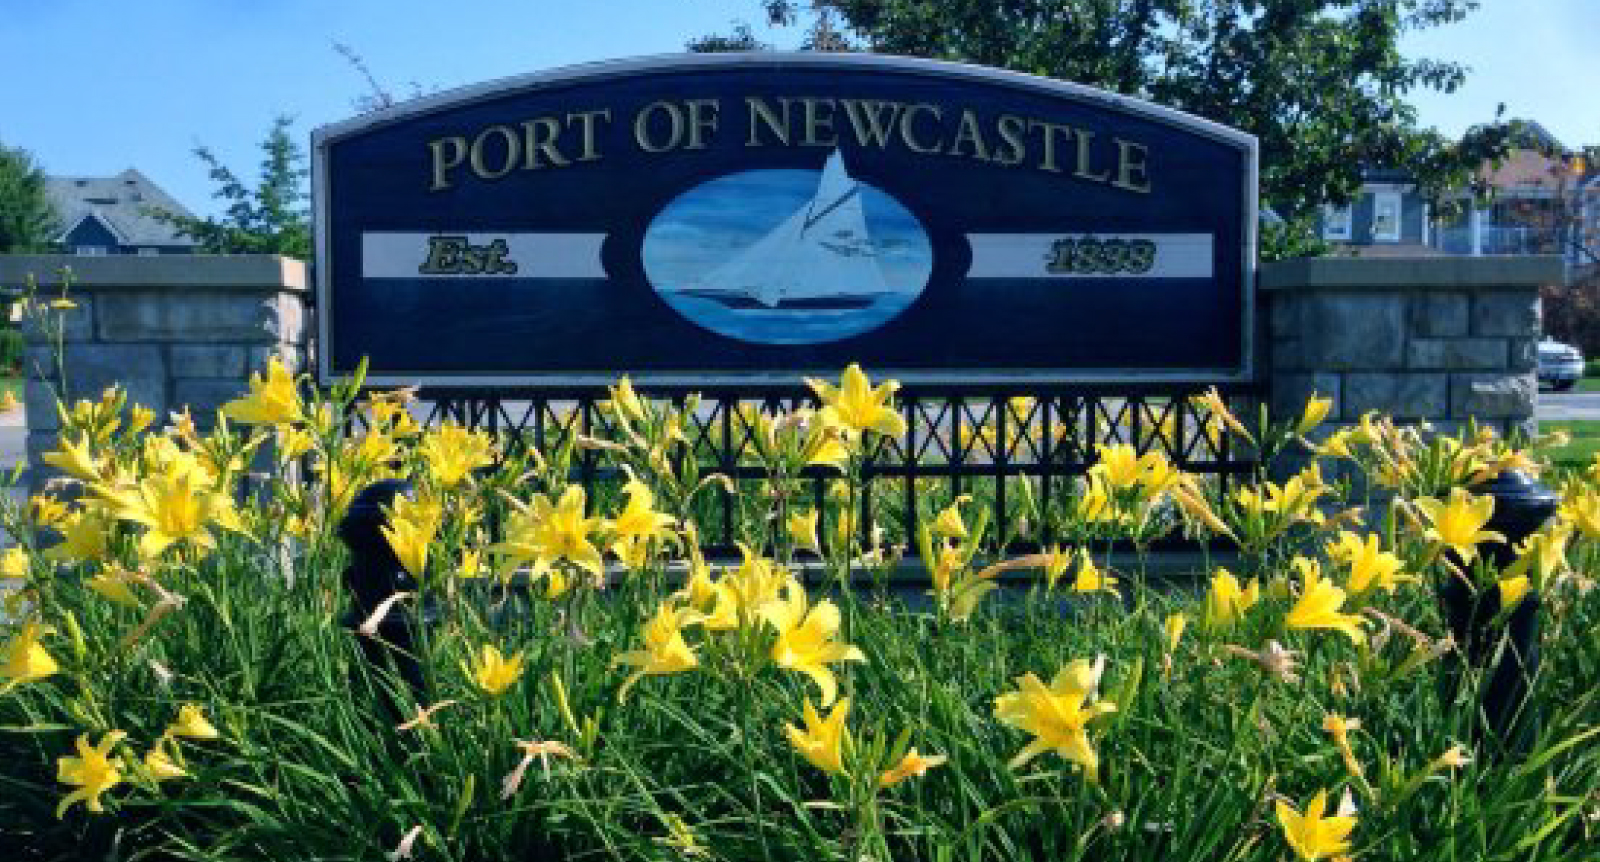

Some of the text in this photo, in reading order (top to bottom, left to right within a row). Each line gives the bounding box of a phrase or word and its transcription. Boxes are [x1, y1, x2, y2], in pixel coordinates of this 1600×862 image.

[428, 96, 1151, 194] PORT OF NEWCASTLE
[418, 236, 518, 275] Est.
